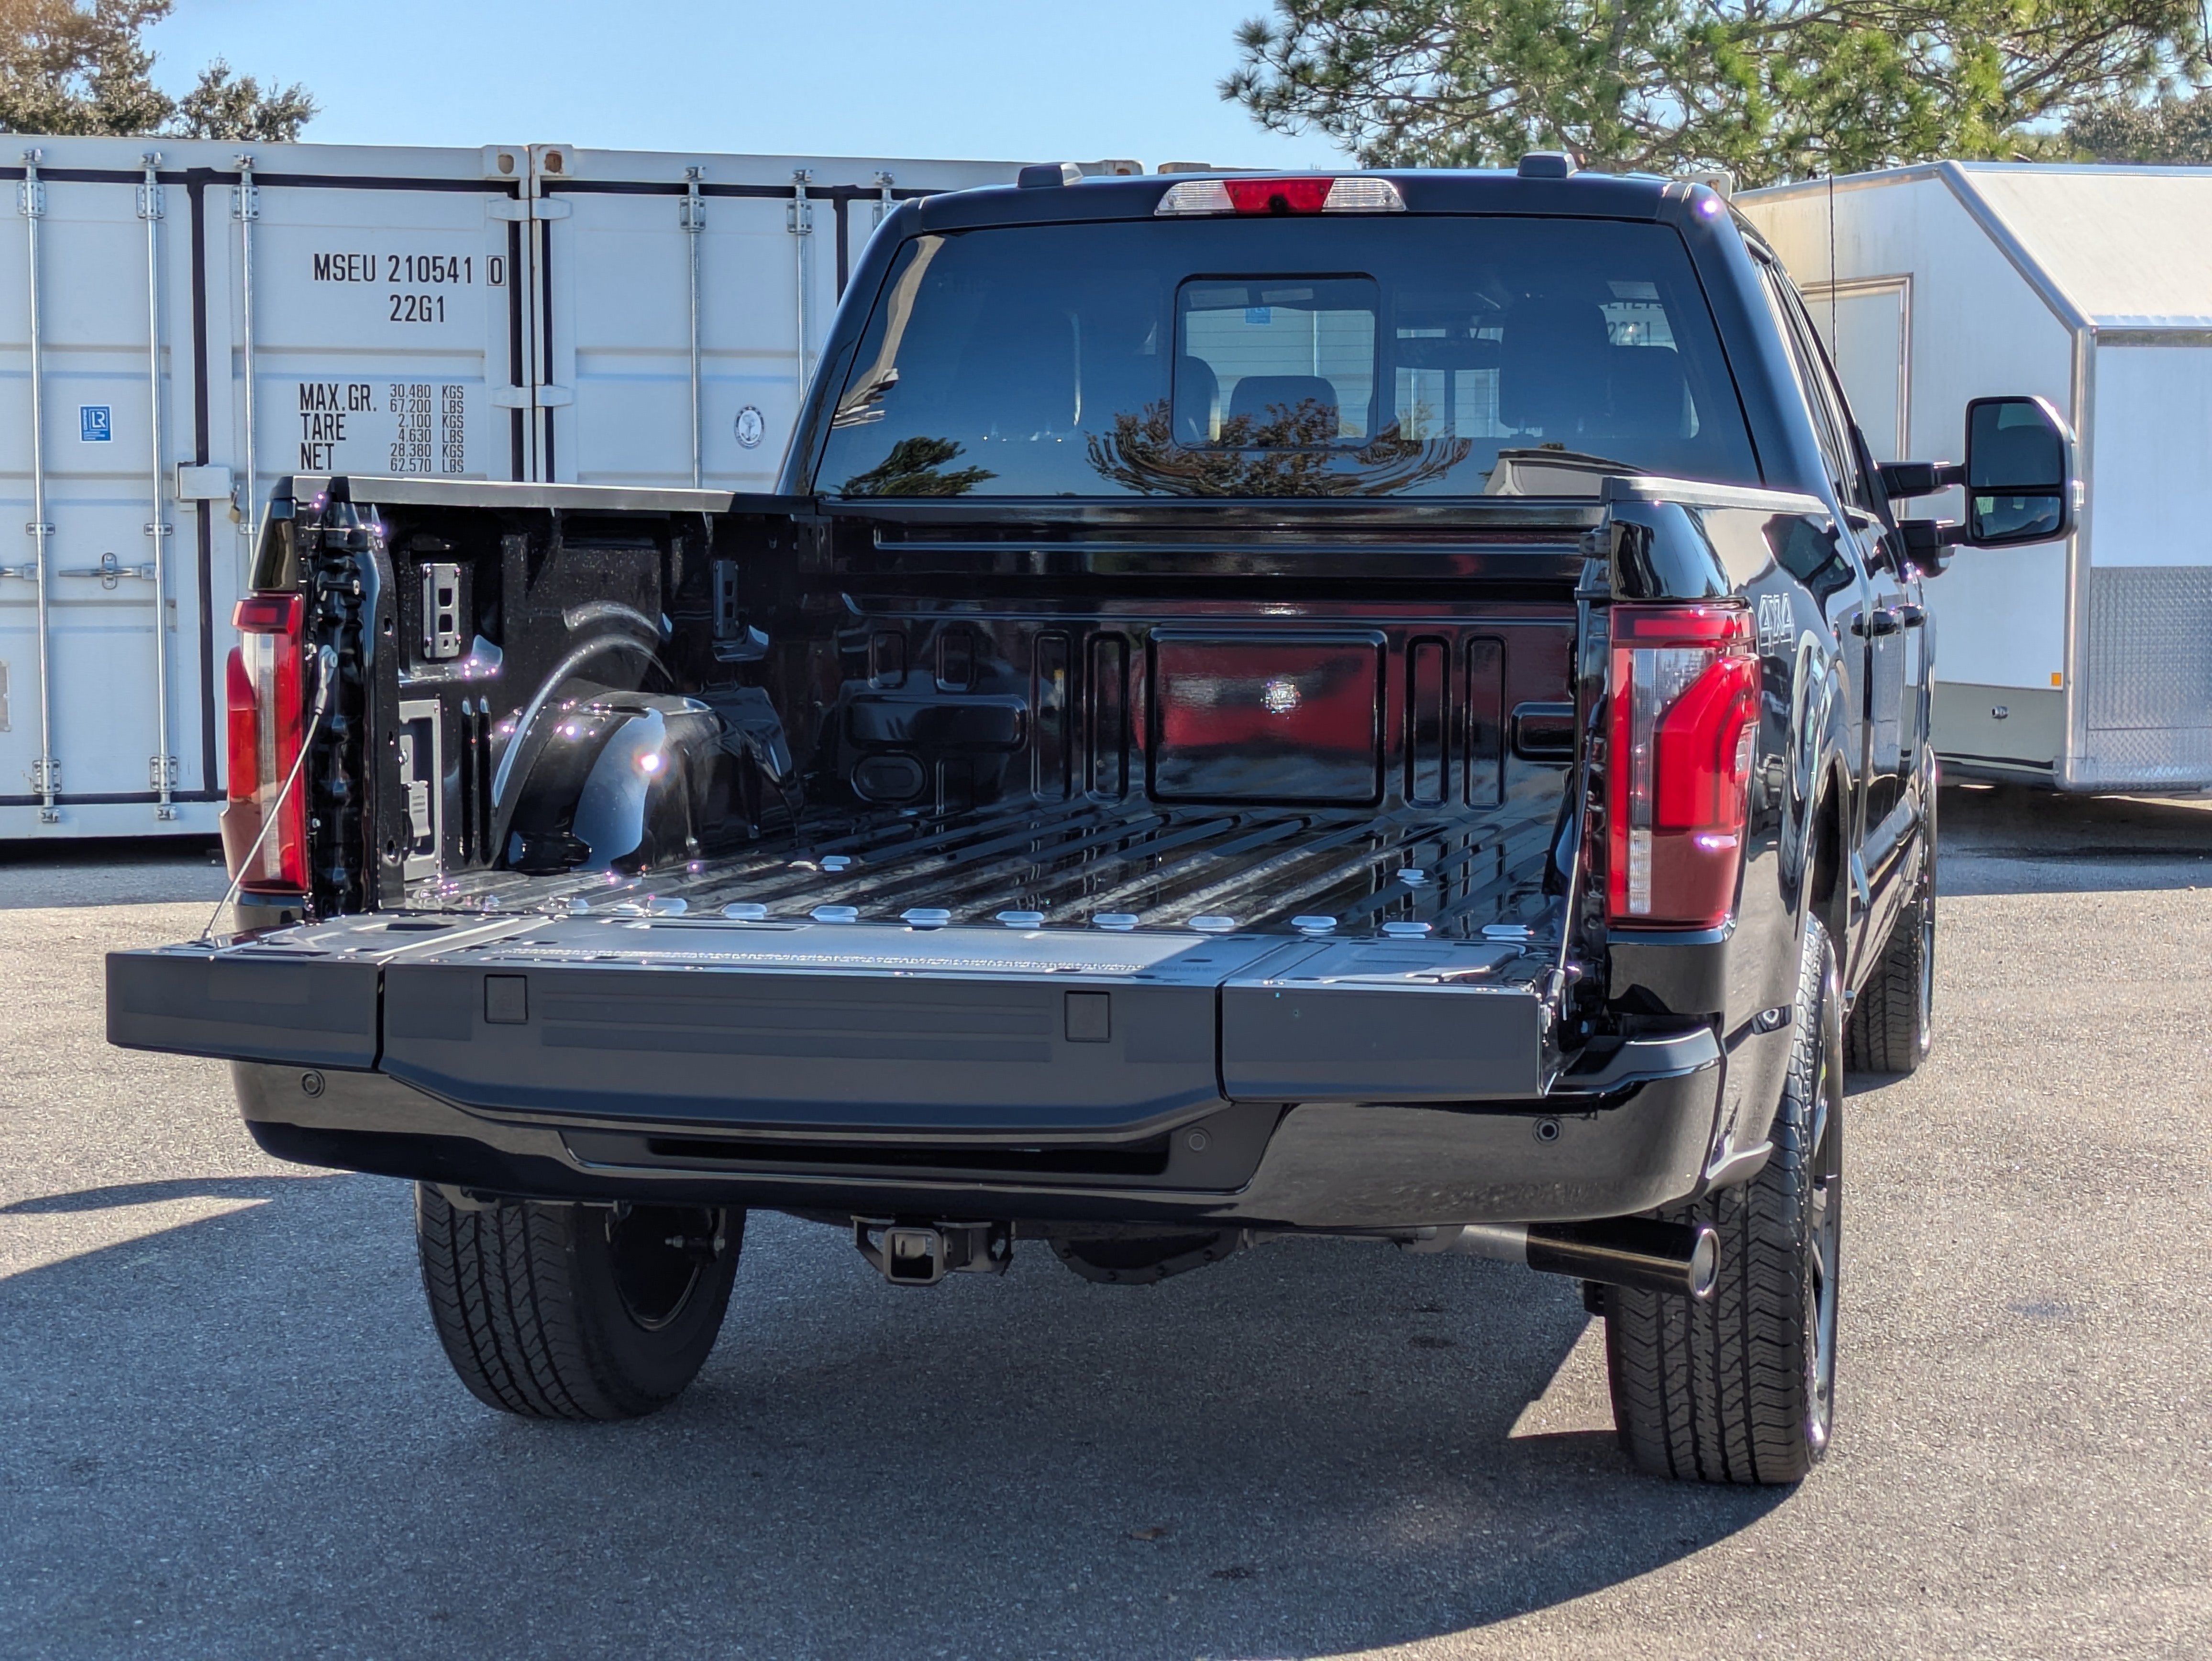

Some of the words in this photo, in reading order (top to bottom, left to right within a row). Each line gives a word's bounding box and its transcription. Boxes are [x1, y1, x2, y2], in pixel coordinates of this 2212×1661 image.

[314, 253, 376, 282] MSEU
[387, 255, 472, 284] 210541
[489, 257, 503, 285] 0
[389, 294, 444, 322] 22G1
[299, 383, 377, 412] MAX.GR.
[442, 385, 464, 399] KGS
[442, 399, 464, 414] LBS
[300, 412, 347, 441] TARE
[398, 413, 431, 428] 2.100
[442, 415, 464, 429] KGS
[398, 428, 431, 443] 4.630
[442, 429, 464, 443] LBS
[300, 443, 335, 470] NET
[442, 444, 464, 458] KGS
[442, 459, 464, 473] LBS
